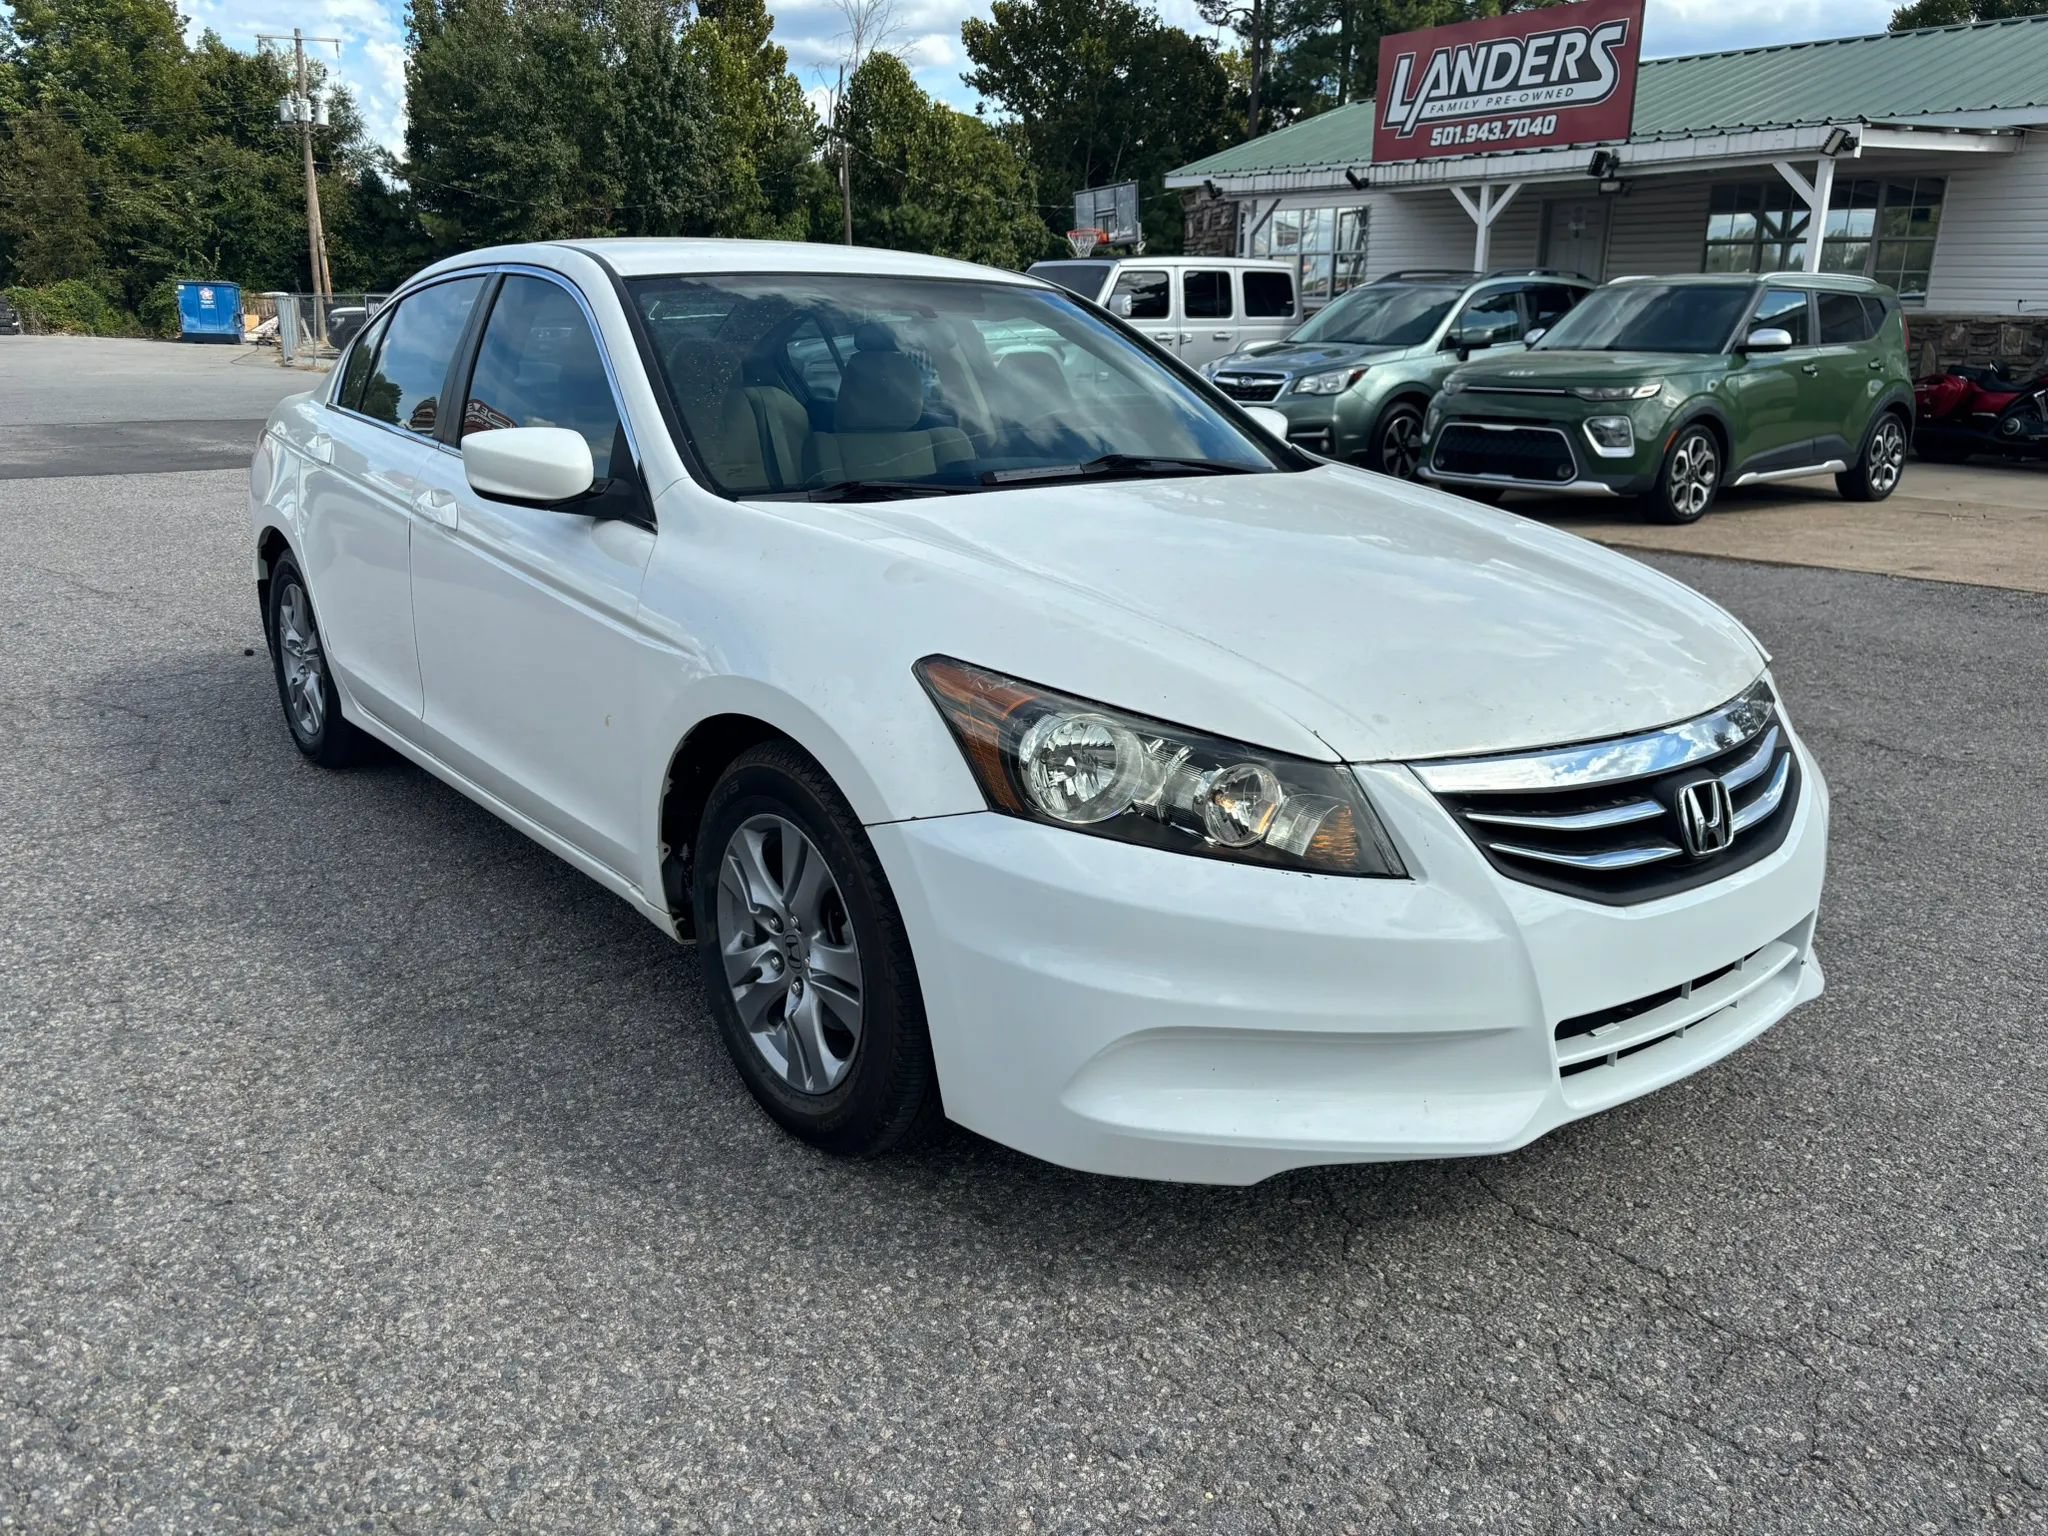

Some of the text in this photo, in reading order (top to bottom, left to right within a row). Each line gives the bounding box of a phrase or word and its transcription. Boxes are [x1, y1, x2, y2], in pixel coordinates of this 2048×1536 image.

[1386, 24, 1625, 133] LANDERS
[1429, 87, 1574, 114] FAMILY PRE-OWNED
[1429, 114, 1558, 147] 501.943.7040
